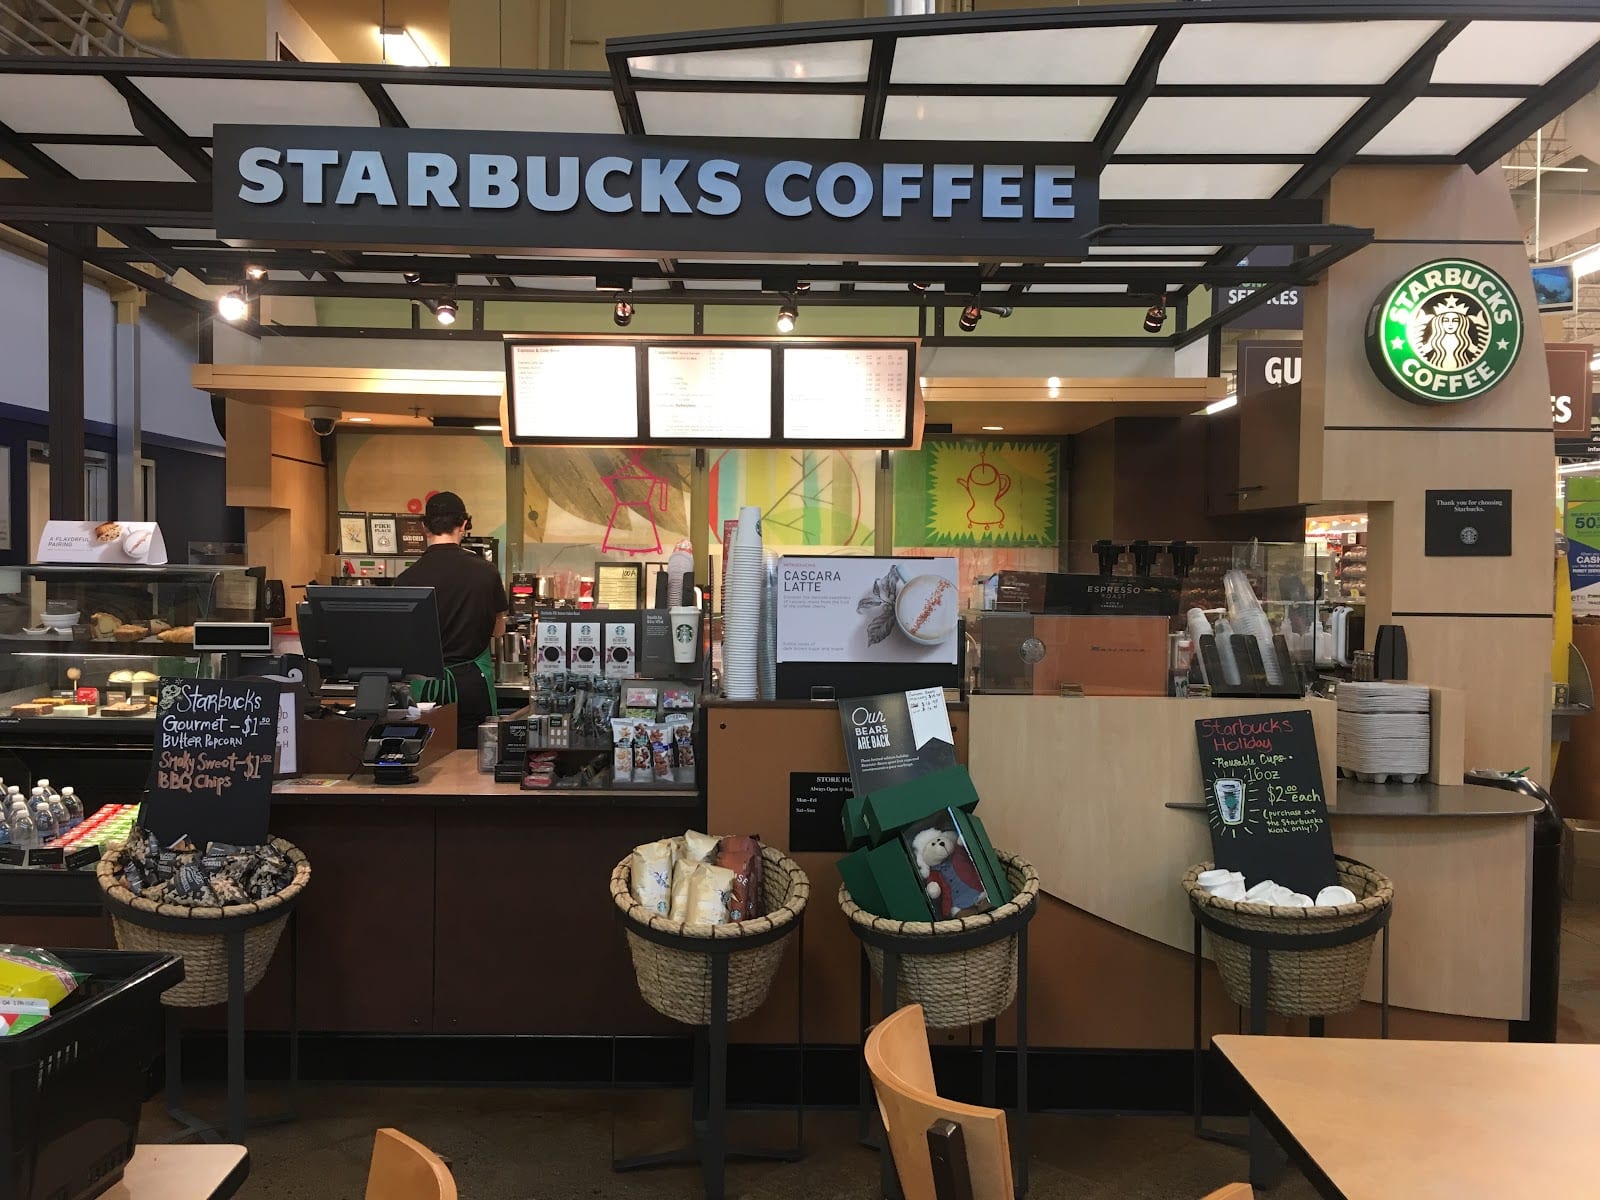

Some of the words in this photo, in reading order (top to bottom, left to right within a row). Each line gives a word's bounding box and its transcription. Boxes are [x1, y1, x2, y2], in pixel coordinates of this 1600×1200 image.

[238, 146, 741, 216] STARBUCKS
[764, 160, 1076, 219] COFFEE
[1228, 289, 1298, 306] SECES
[1389, 267, 1513, 325] STARBUCKS
[1401, 358, 1496, 393] COFFEE
[1575, 517, 1596, 528] 50
[783, 570, 841, 581] CASCARA
[783, 581, 822, 592] LATTE
[1087, 585, 1141, 594] ESPRESSO
[162, 714, 228, 733] Gourmet
[852, 707, 886, 726] Our
[854, 724, 888, 736] BEARS
[1201, 718, 1294, 738] Starbucks
[857, 734, 872, 750] ARE
[870, 733, 891, 749] BACK
[1213, 736, 1273, 752] Holiday
[158, 770, 192, 794] BBQ
[194, 774, 233, 796] Chips
[1292, 788, 1322, 803] each
[1280, 816, 1324, 826] Starbucks
